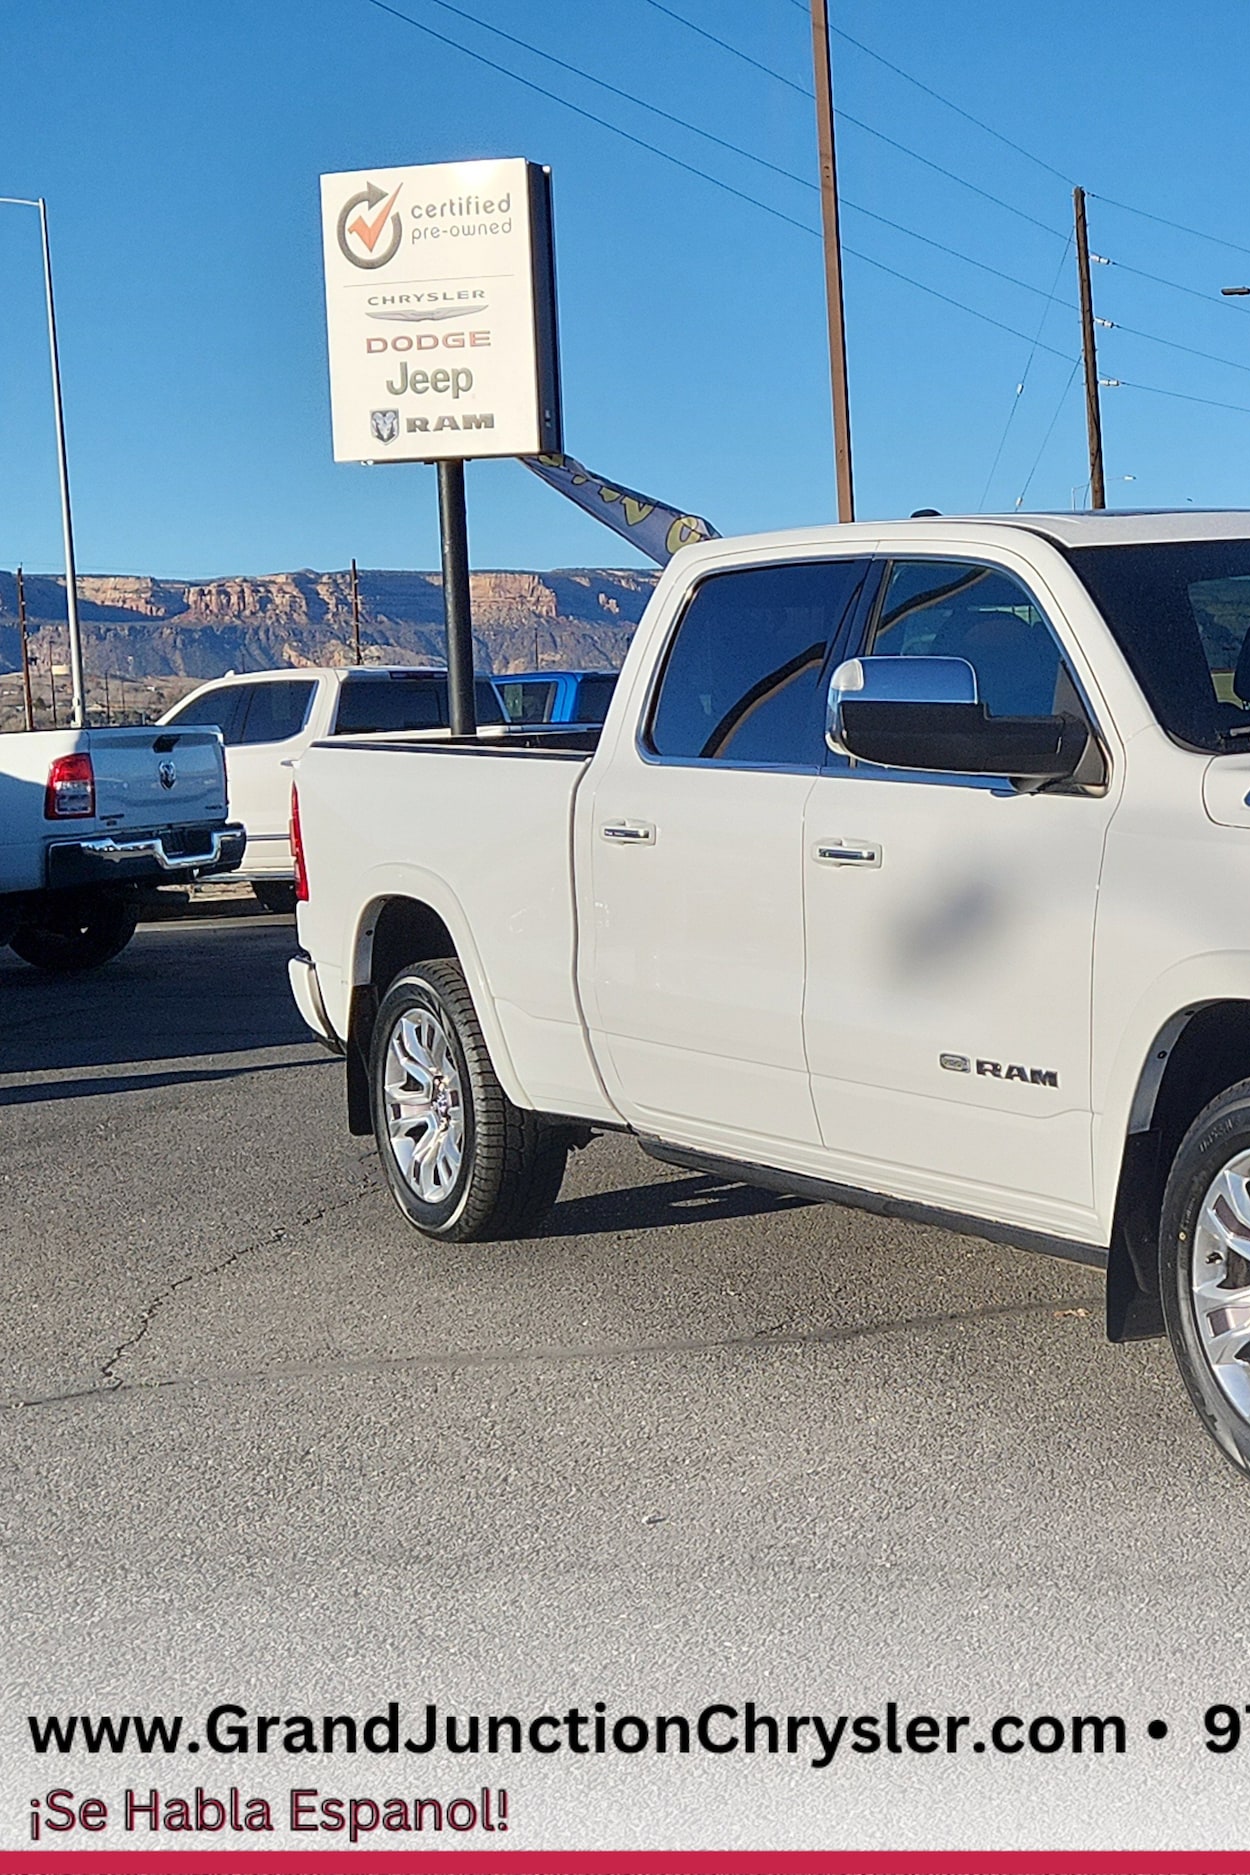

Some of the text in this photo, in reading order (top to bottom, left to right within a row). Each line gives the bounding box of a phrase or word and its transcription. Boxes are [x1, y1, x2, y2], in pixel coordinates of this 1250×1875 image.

[411, 193, 511, 219] certified
[411, 217, 512, 244] pre-owned
[367, 290, 485, 306] CHRYSLER
[366, 331, 491, 353] DODGE
[386, 361, 473, 399] Jeep
[406, 413, 494, 433] RAM
[976, 1058, 1059, 1089] RAM
